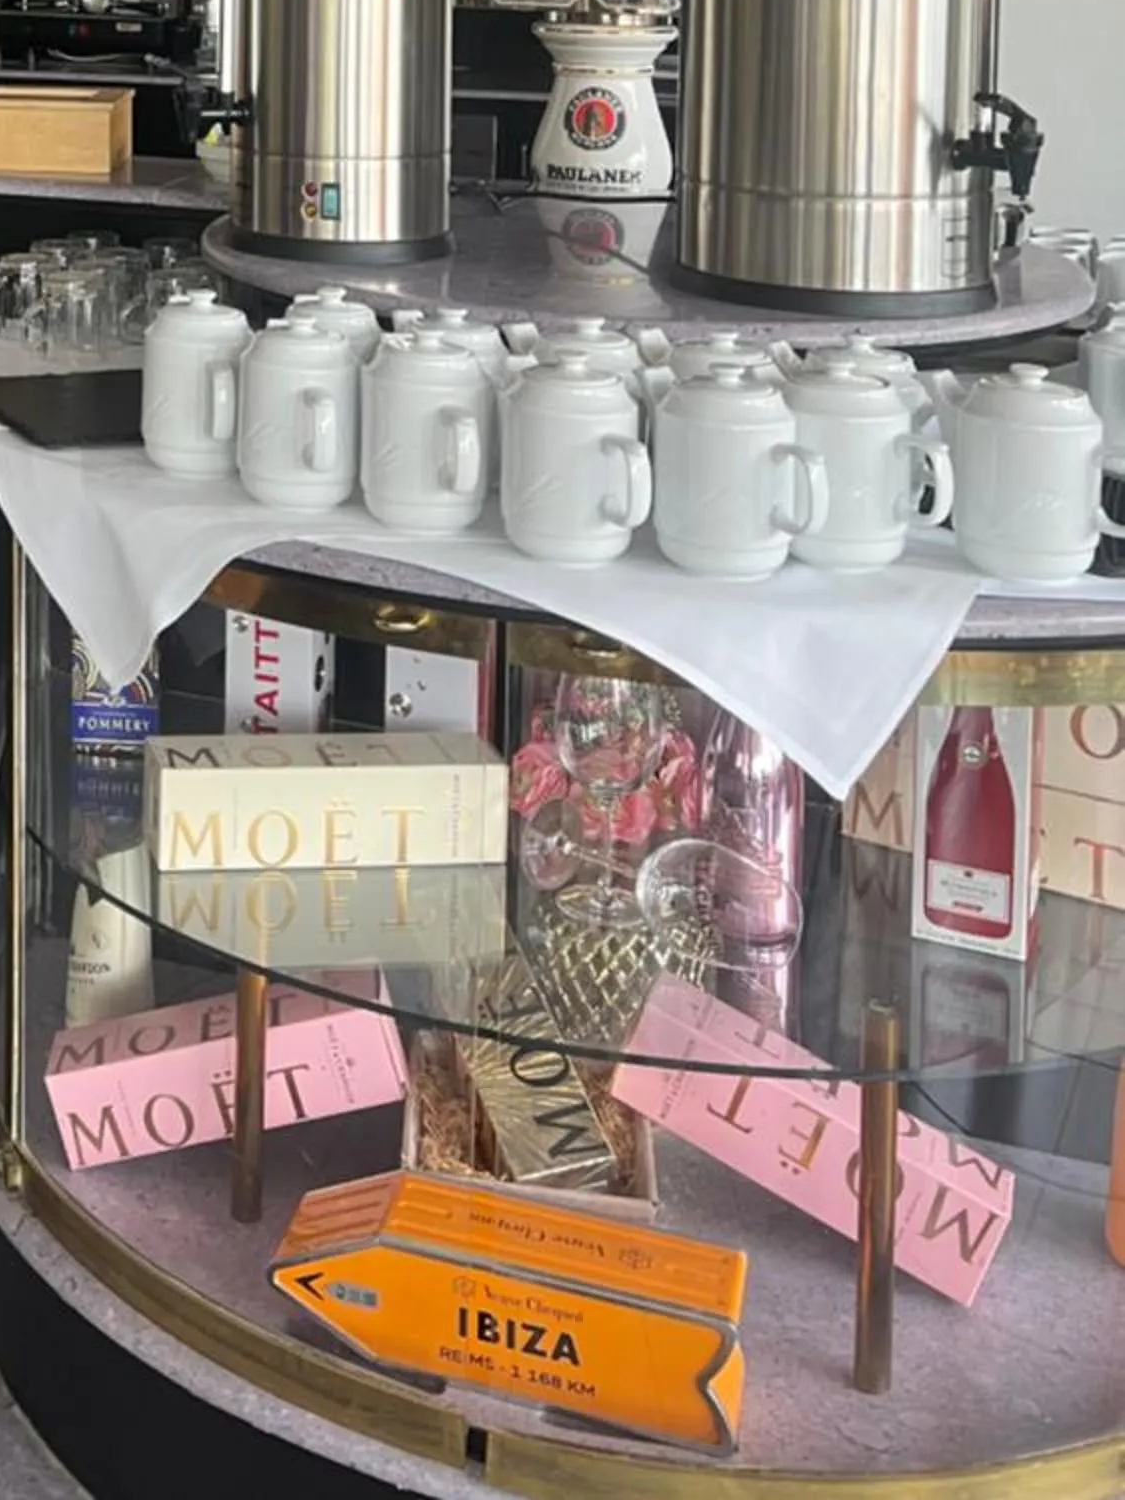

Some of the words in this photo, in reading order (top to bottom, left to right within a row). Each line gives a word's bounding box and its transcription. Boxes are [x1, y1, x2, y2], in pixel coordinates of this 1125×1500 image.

[546, 164, 645, 184] PAULANER
[78, 716, 152, 732] POMMERY
[167, 797, 427, 870] MOËT
[458, 1307, 580, 1367] IBIZA
[567, 1379, 596, 1397] KM
